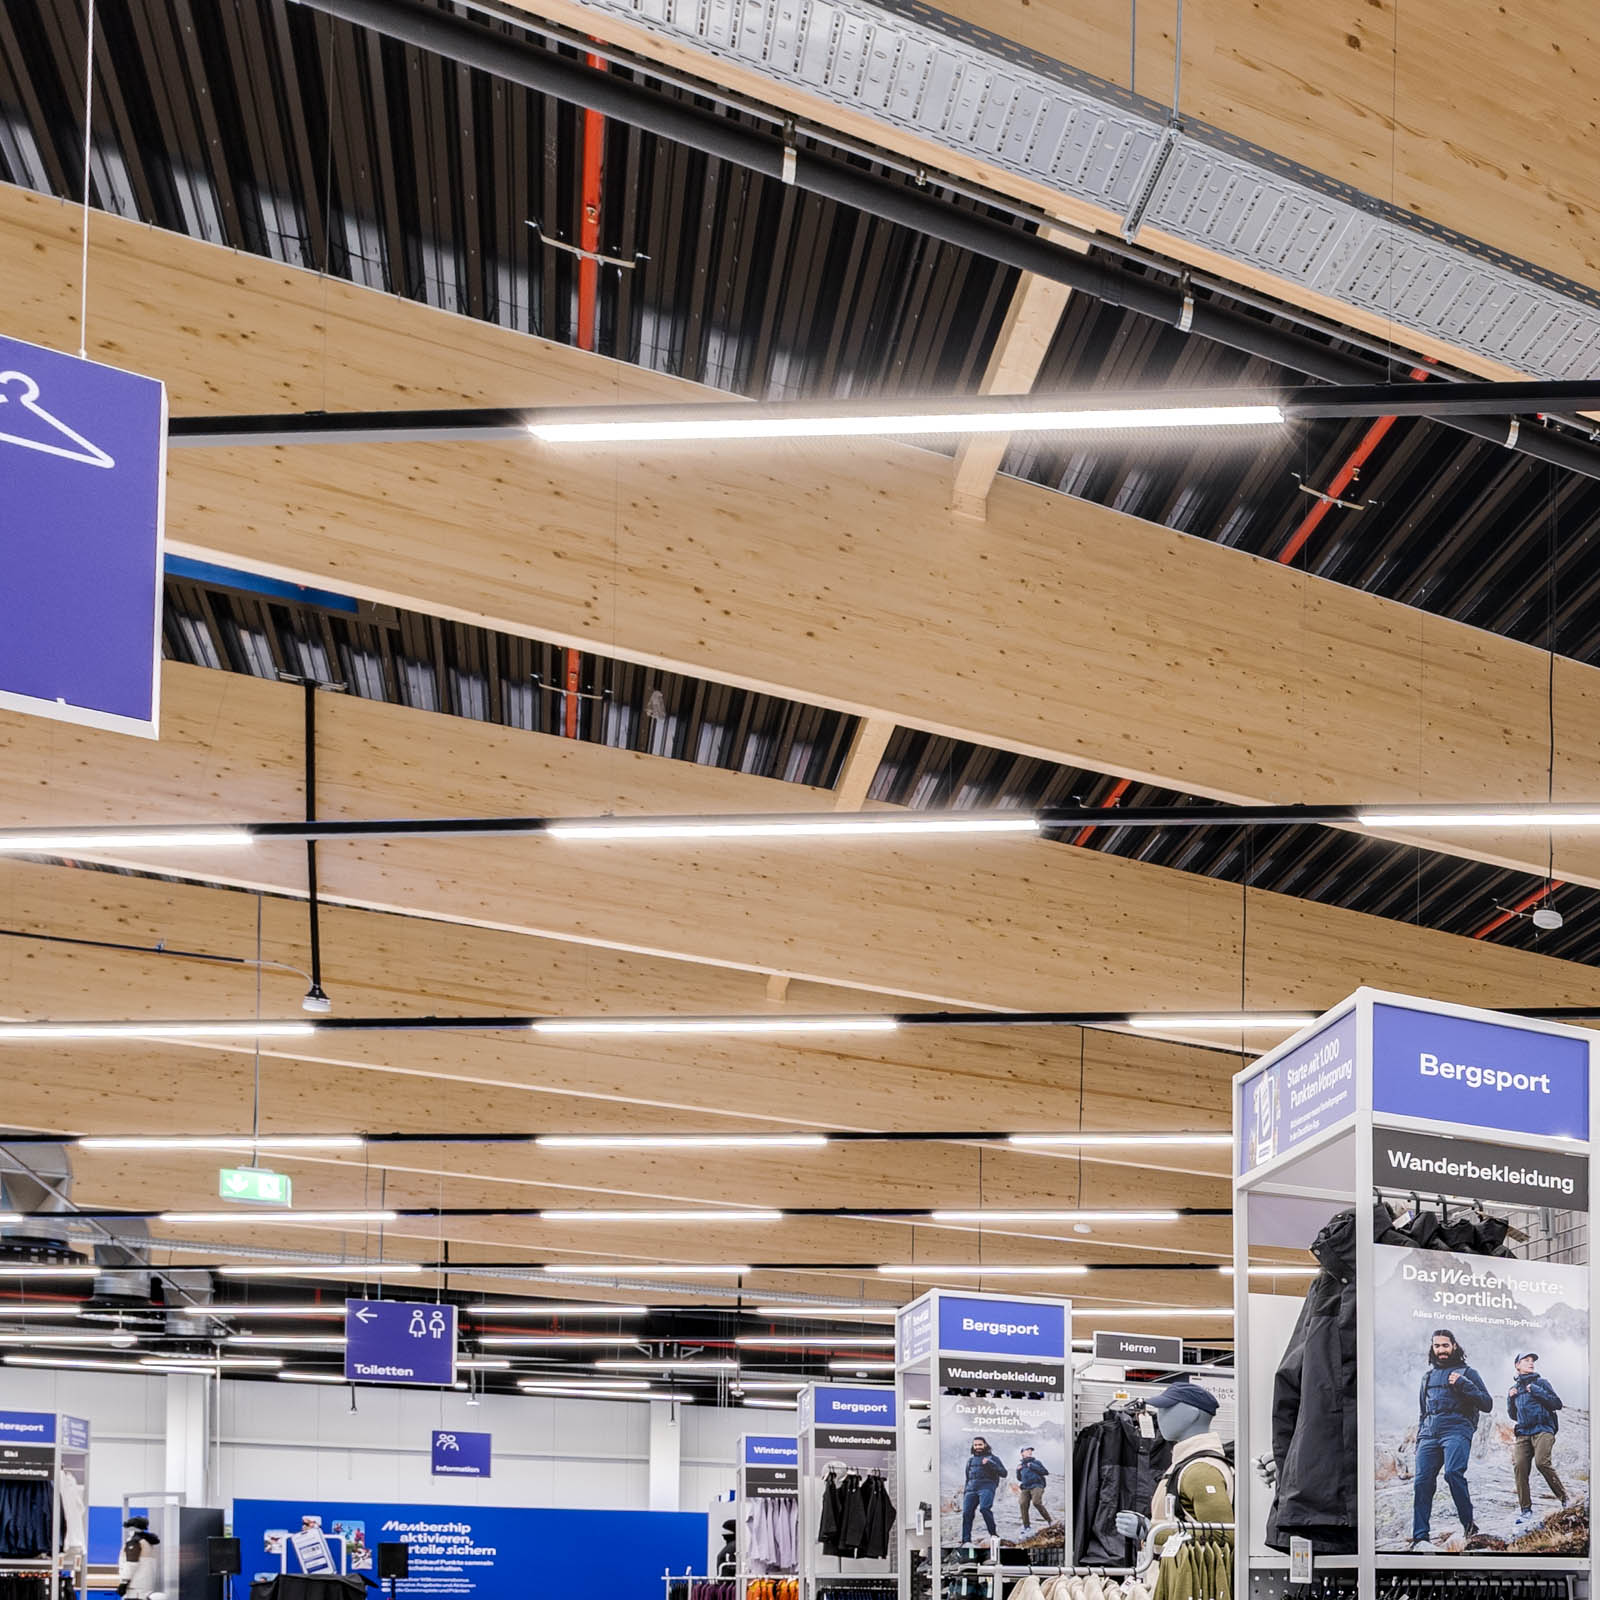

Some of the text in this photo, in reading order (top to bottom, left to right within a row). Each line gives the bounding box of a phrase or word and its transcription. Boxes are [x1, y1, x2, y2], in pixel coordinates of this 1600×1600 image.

[1287, 1065, 1308, 1088] Starte
[1307, 1051, 1320, 1076] mit
[1420, 1053, 1550, 1093] Bergsport
[1290, 1059, 1353, 1109] Punkten Vorsprung
[1387, 1149, 1574, 1194] Wanderbekleidung
[1402, 1264, 1564, 1296] Das Wetter heute:
[1433, 1288, 1518, 1311] sportlich.
[1413, 1310, 1432, 1320] Alles
[1433, 1311, 1444, 1321] für
[1446, 1312, 1460, 1322] den
[1461, 1313, 1487, 1324] Herbst
[1488, 1318, 1504, 1326] zum
[962, 1318, 1039, 1336] Bergsport
[1119, 1342, 1156, 1354] Herren
[354, 1363, 414, 1377] Toiletten
[948, 1367, 1057, 1386] Wanderbekleidung
[832, 1401, 887, 1413] Bergsport
[955, 1404, 976, 1414] Das
[977, 1405, 1017, 1417] Wetter
[973, 1416, 1023, 1427] sportlich.
[828, 1435, 891, 1445] Wanderschuhe
[753, 1445, 798, 1456] Winterspo
[435, 1464, 480, 1474] Information
[381, 1520, 472, 1534] Membership
[400, 1533, 474, 1546] aktivieren,
[408, 1545, 496, 1556] rteile sichern
